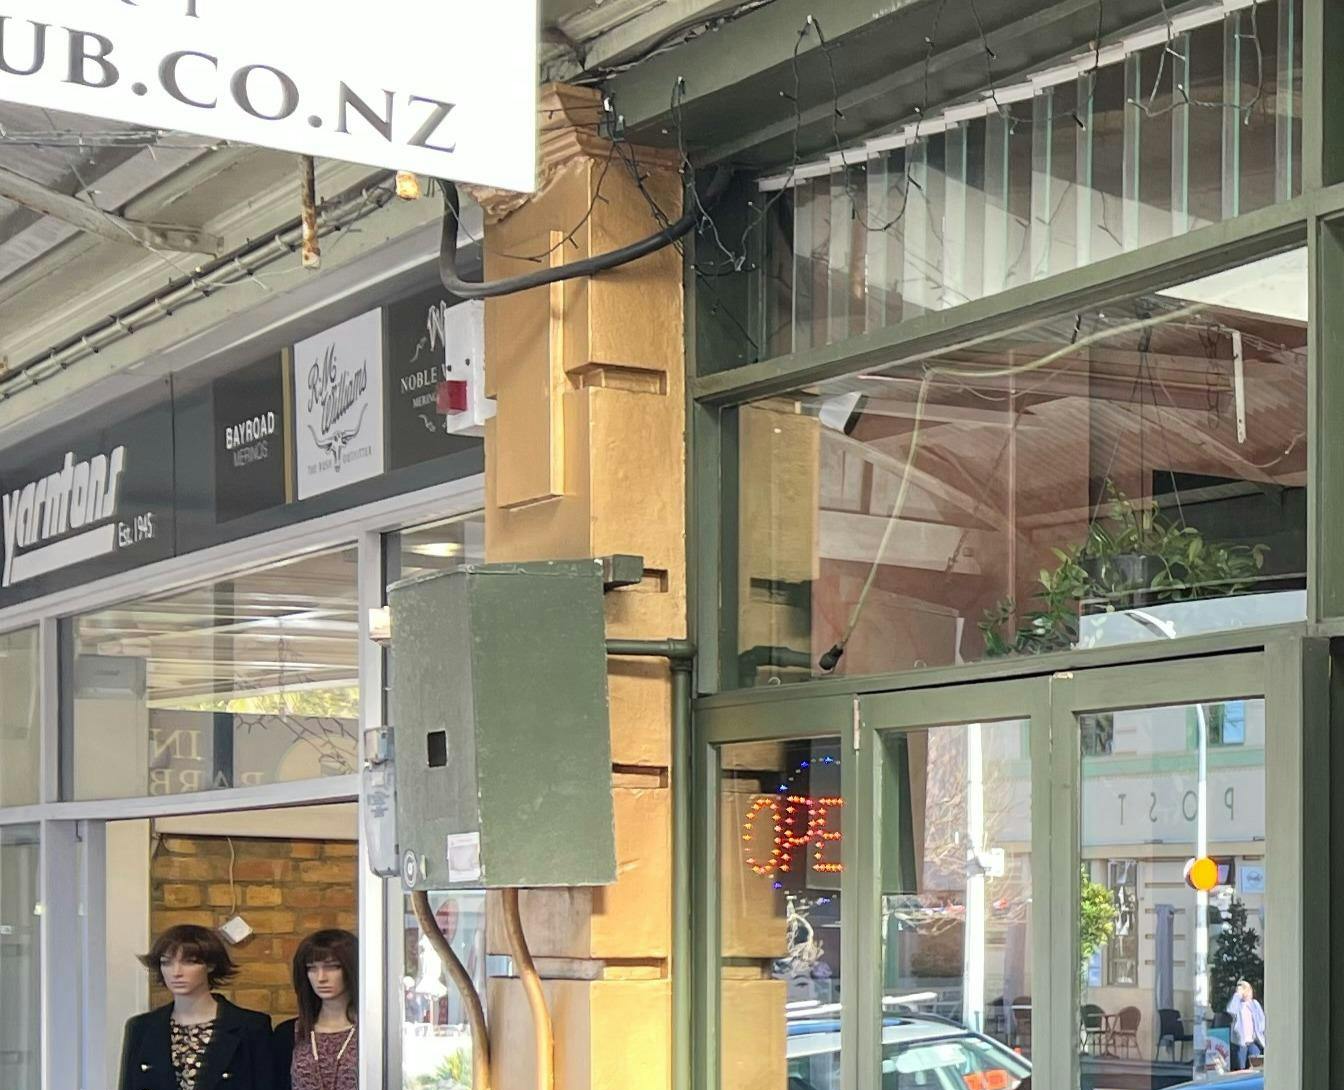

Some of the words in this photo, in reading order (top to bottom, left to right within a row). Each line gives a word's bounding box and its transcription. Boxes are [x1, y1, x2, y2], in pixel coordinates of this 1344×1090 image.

[401, 366, 438, 394] NOBLE
[225, 412, 275, 449] BAYROAD
[134, 512, 154, 543] 1945
